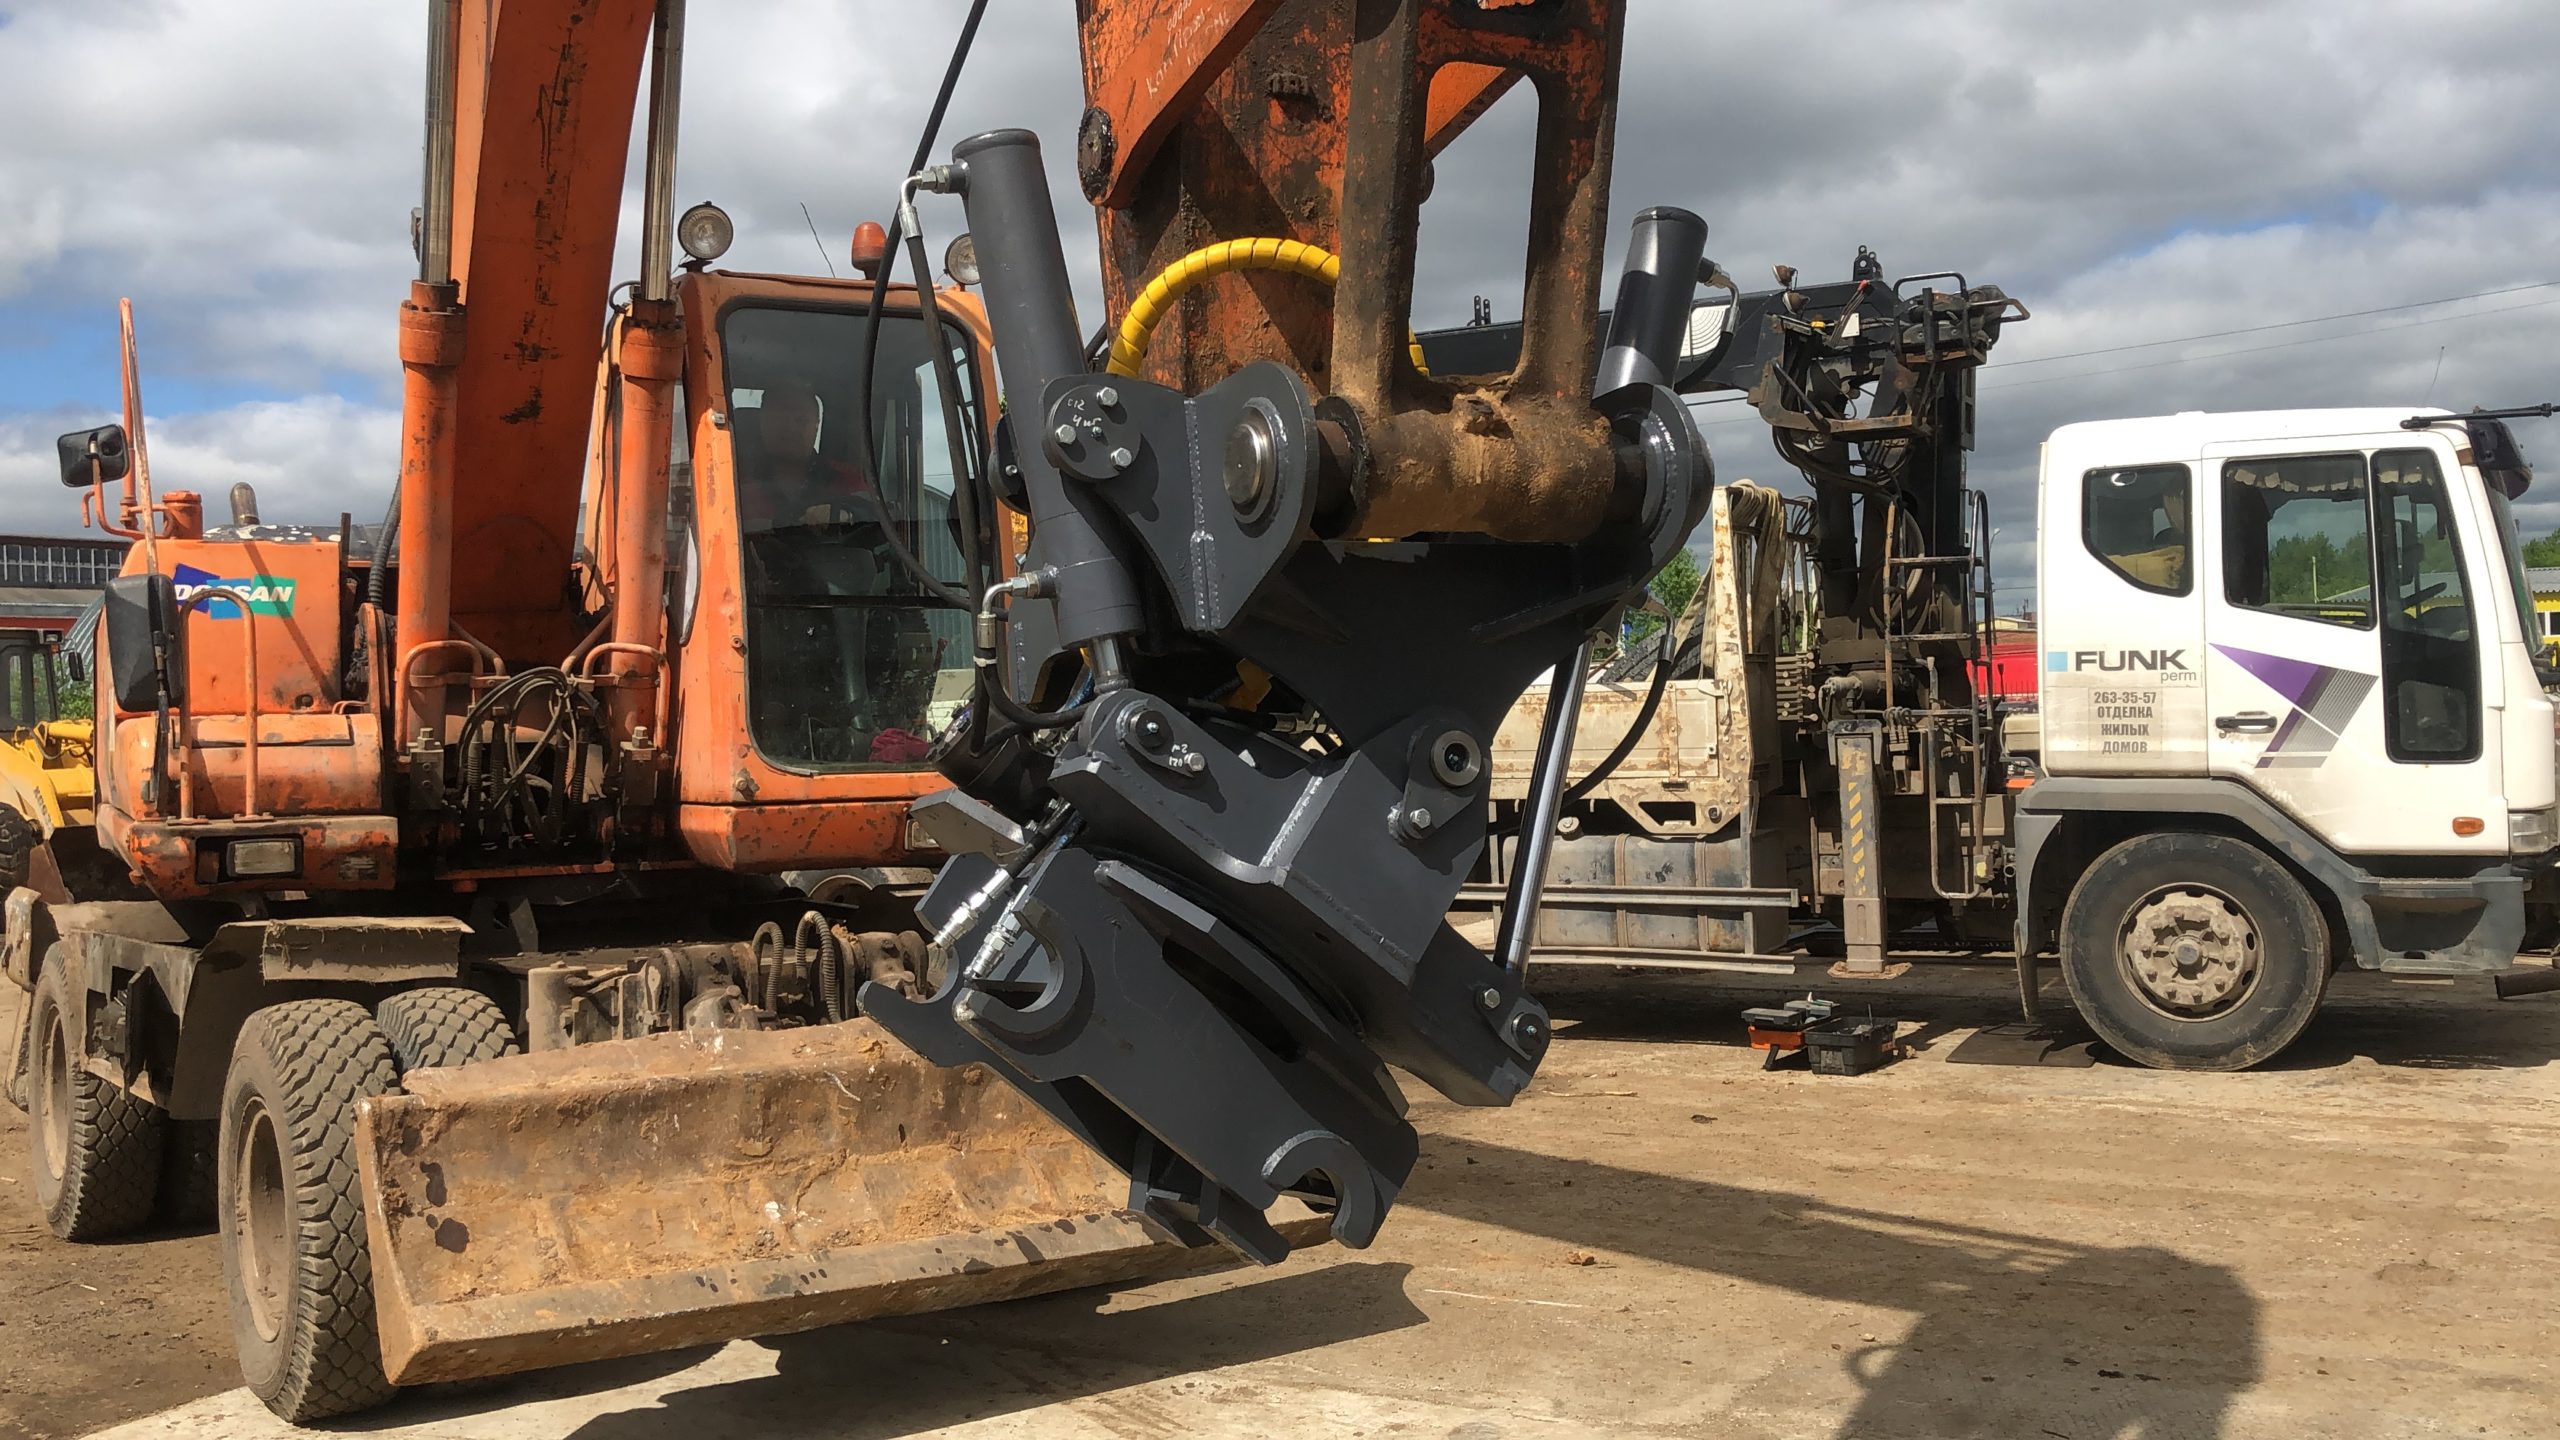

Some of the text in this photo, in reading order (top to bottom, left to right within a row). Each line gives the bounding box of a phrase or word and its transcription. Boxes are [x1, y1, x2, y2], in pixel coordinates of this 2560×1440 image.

[2075, 649, 2189, 671] FUNK
[2160, 671, 2197, 684] perm
[2093, 691, 2157, 704] 263-35-57
[2097, 706, 2154, 720] ОТДЕЛКА
[2101, 723, 2150, 736] ЖИЛЫХ
[2102, 741, 2148, 755] ДОМОВ
